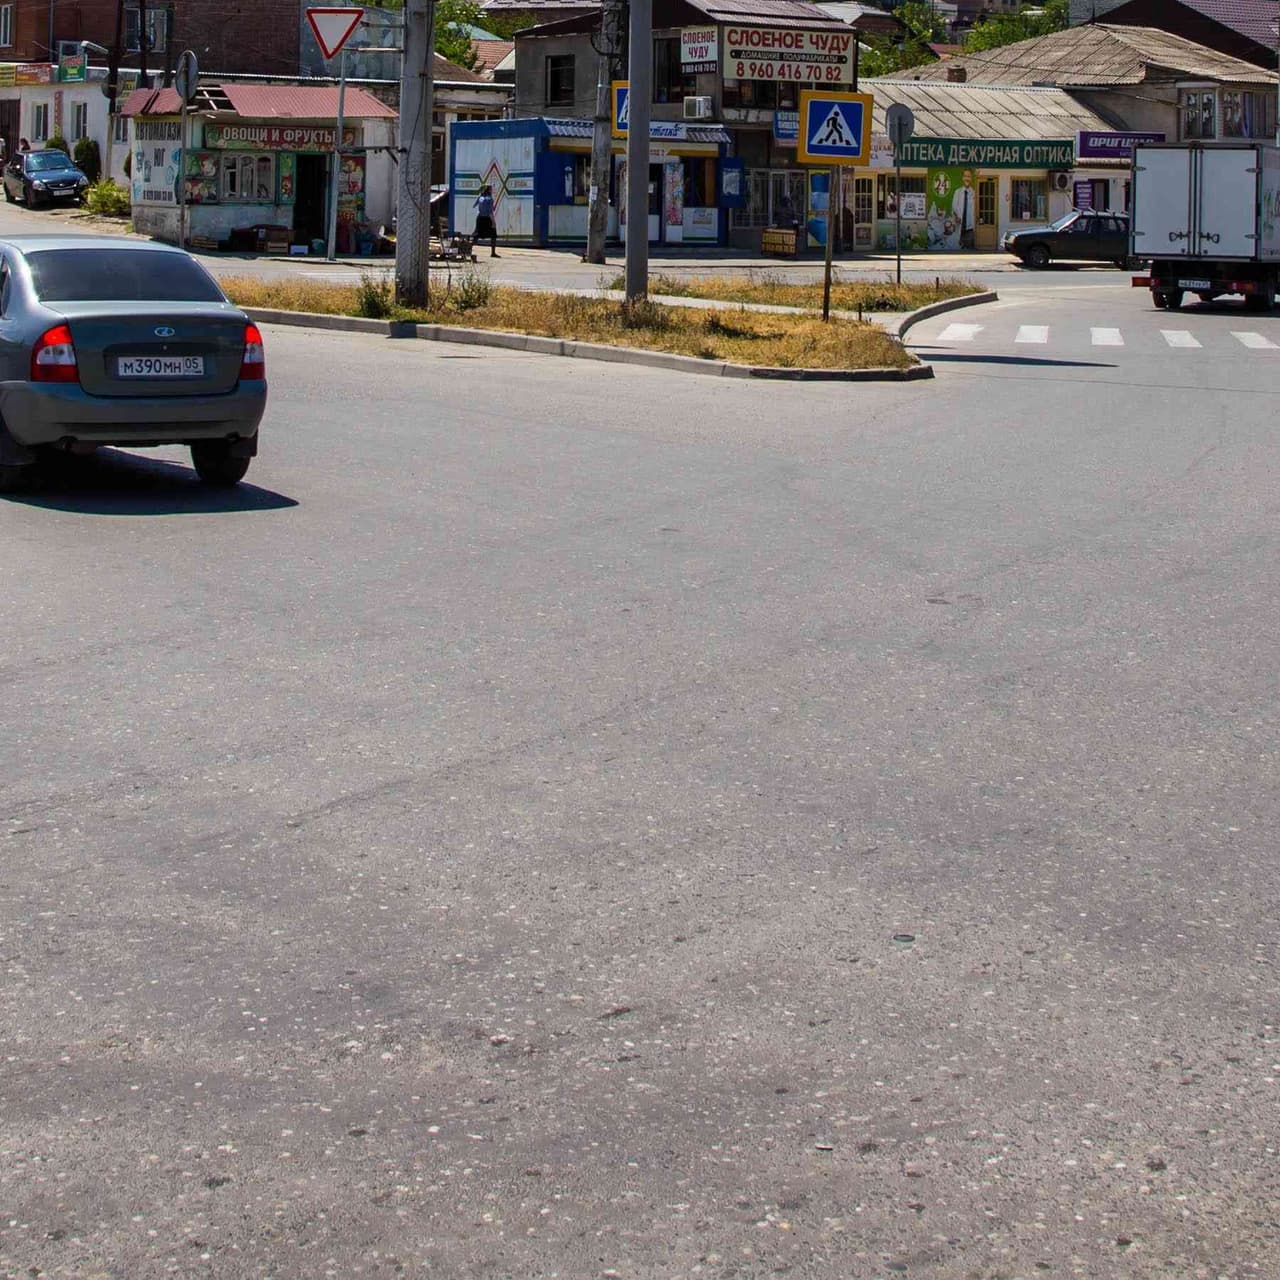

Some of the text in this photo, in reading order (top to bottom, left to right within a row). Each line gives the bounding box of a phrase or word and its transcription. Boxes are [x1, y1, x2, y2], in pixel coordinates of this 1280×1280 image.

[682, 30, 716, 59] СЛОЕНОЕ ЧУДУ
[727, 29, 851, 54] СЛОЕНОЕ ЧУДУ
[736, 61, 841, 81] 8 960 416 70 82
[223, 127, 336, 143] ОВОЩИ И ФРУКТЫ
[947, 145, 1019, 165] ДЕЖУРНАЯ
[1023, 146, 1073, 164] ОПТИКА
[123, 358, 182, 374] М390МН
